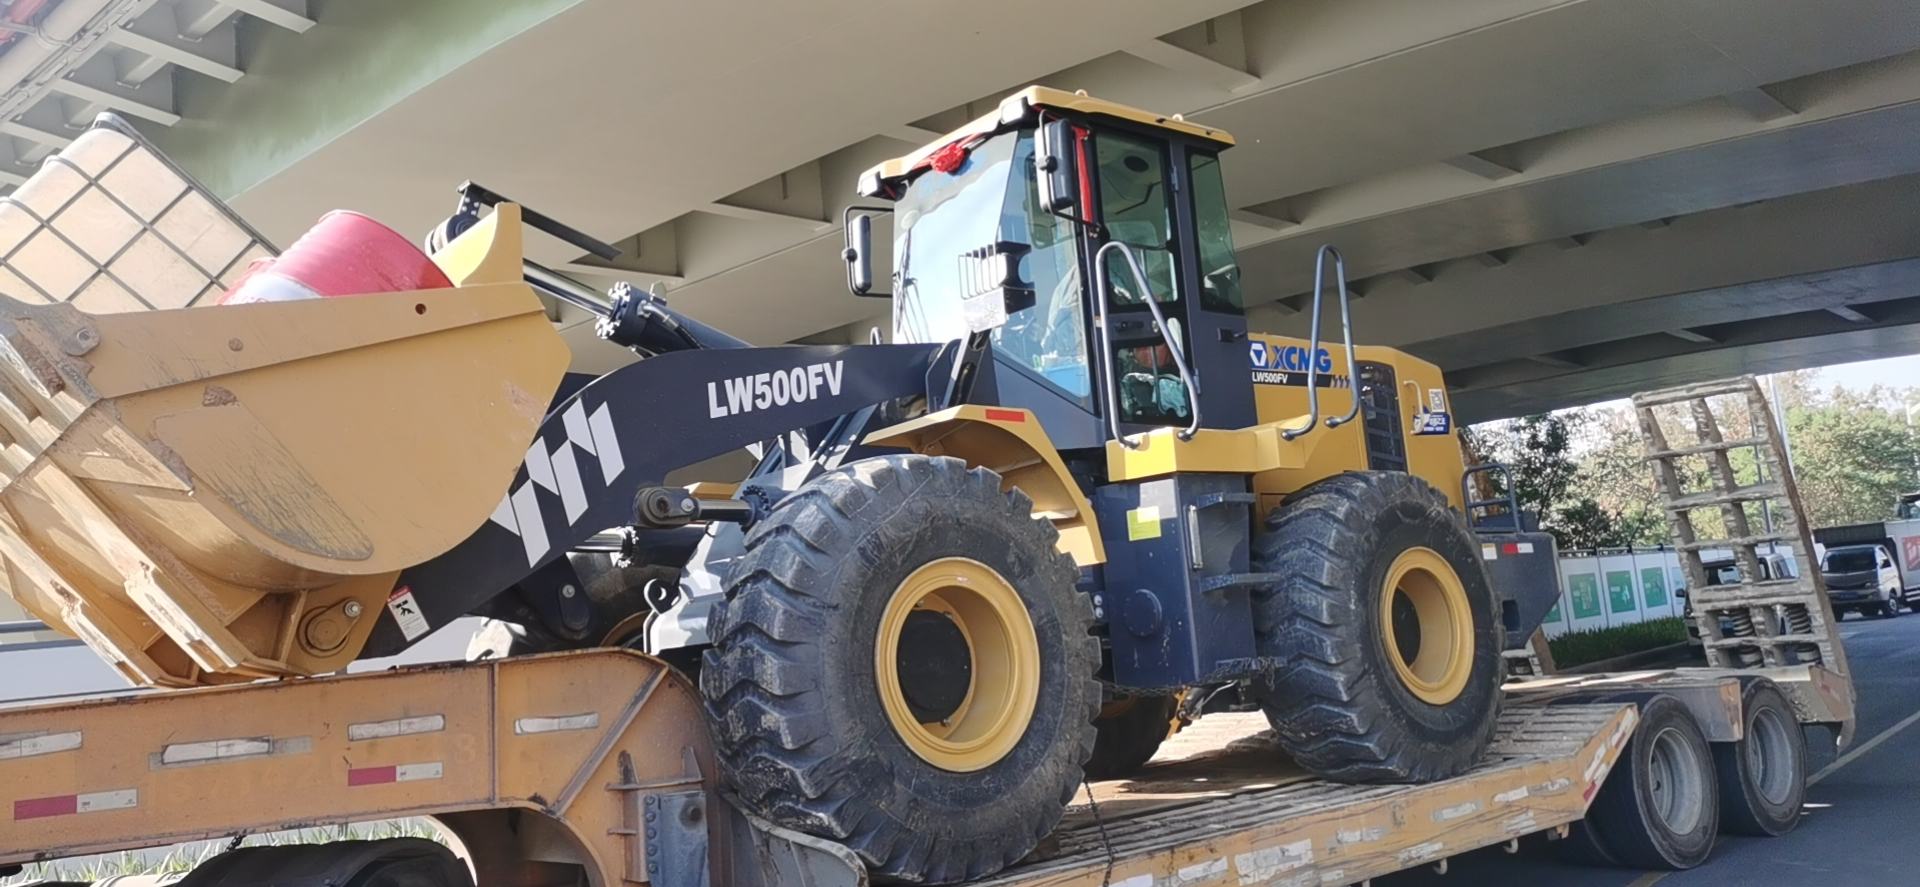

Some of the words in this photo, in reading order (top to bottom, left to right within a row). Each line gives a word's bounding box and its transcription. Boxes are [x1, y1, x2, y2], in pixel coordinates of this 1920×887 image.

[1271, 346, 1332, 373] XCMG
[707, 360, 844, 419] LW500FV
[1252, 371, 1288, 384] LW500FV
